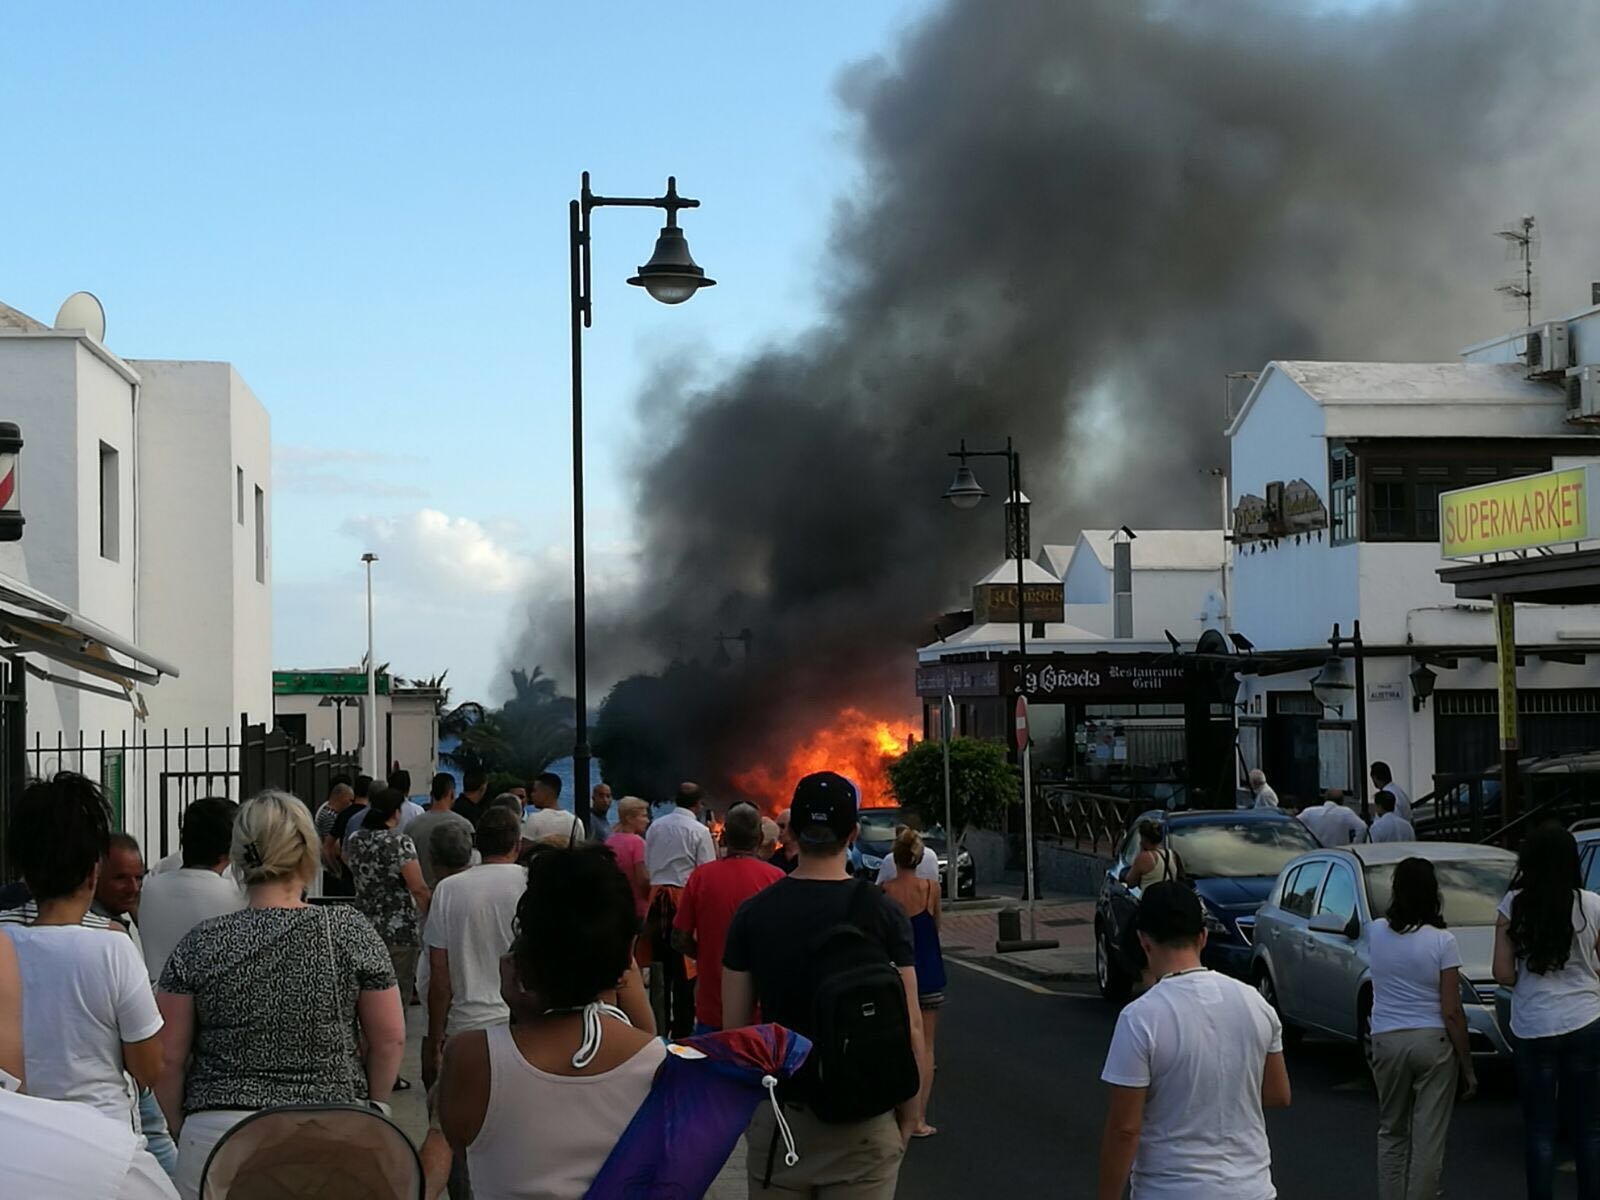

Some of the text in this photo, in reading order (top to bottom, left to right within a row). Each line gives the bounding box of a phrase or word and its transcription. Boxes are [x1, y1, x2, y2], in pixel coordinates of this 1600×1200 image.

[1445, 482, 1583, 545] SUPERMARKET
[1040, 664, 1100, 693] Cañada
[1109, 665, 1184, 678] Restaurante
[1132, 677, 1162, 688] Grill
